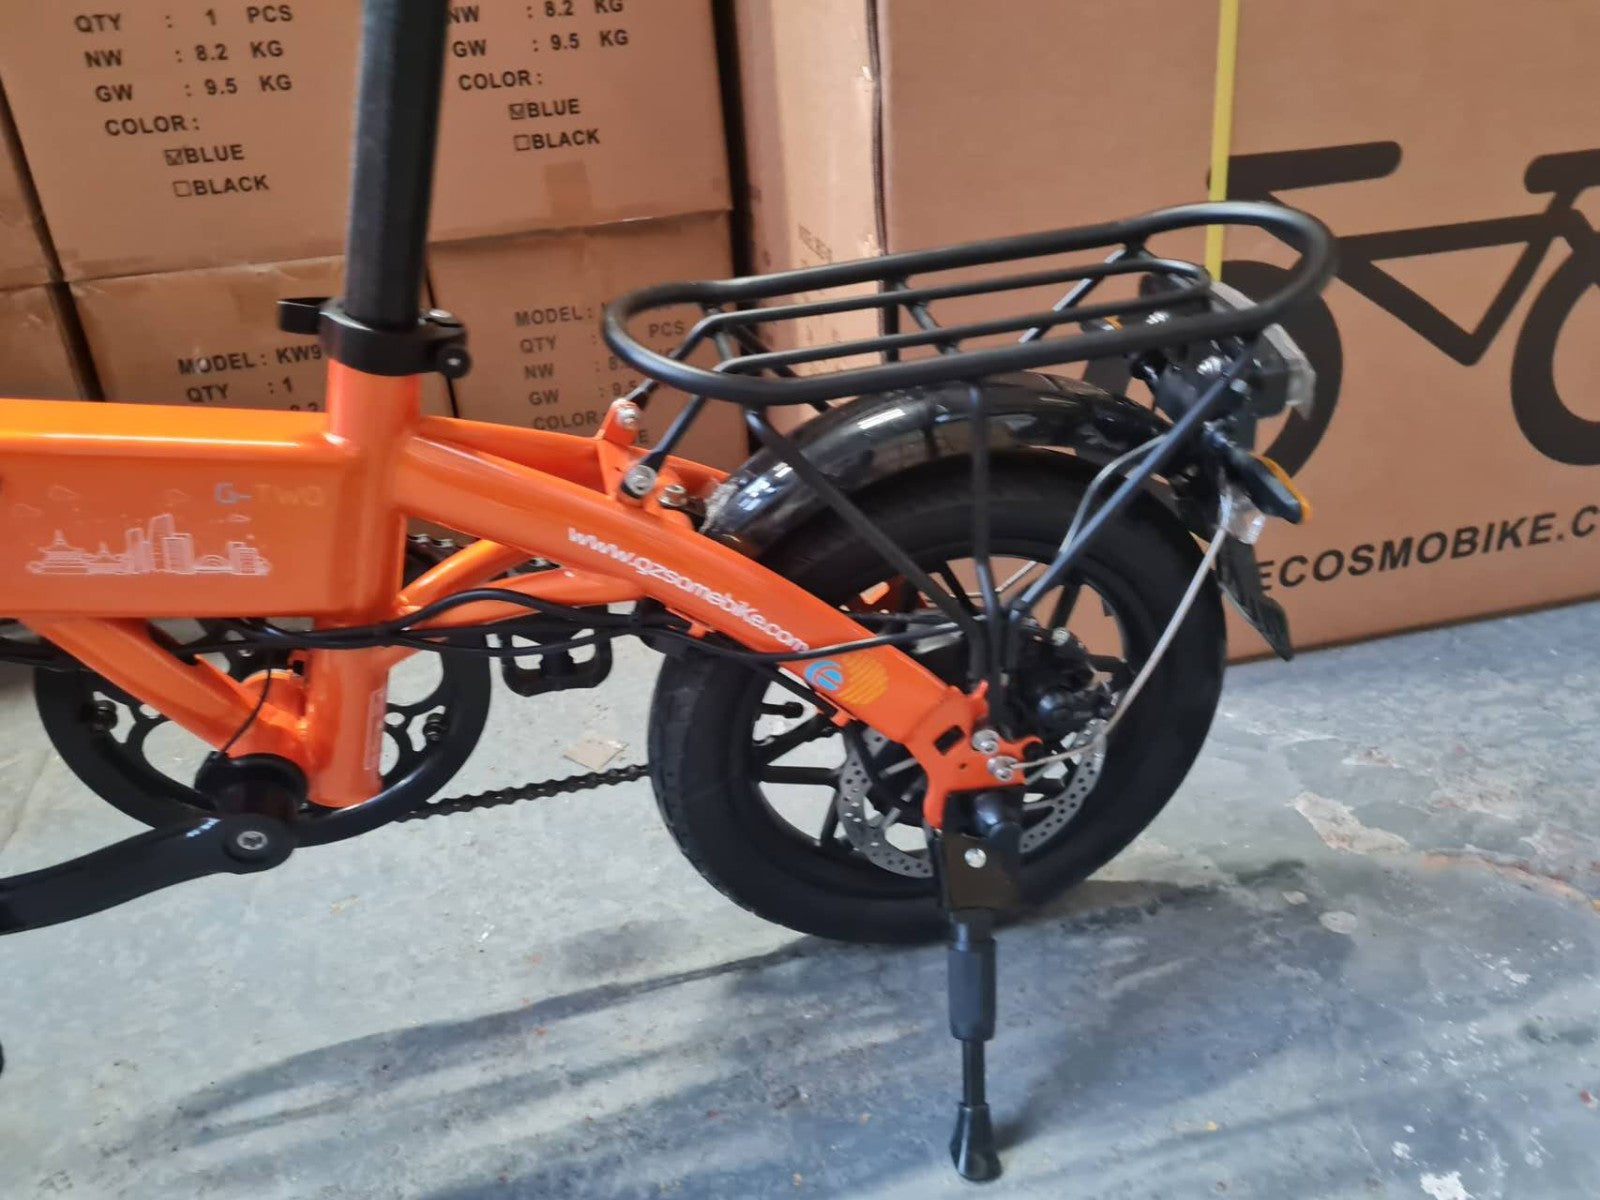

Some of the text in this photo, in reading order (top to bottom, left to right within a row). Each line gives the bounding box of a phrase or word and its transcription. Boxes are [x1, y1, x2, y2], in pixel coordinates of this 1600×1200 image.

[74, 13, 121, 33] QTY
[205, 8, 217, 26] 1
[246, 4, 293, 24] PCS
[449, 5, 480, 24] NW
[544, 0, 574, 17] 8.2
[594, 0, 624, 14] KG
[84, 49, 122, 68] NW
[194, 43, 229, 62] 8.2
[249, 39, 284, 58] KG
[452, 39, 487, 58] GW
[550, 32, 580, 51] 9.5
[599, 29, 629, 47] KG
[95, 84, 133, 103] GW
[204, 77, 238, 96] 9.5
[259, 73, 293, 92] KG
[527, 98, 581, 119] BLUE
[531, 128, 601, 150] BLACK
[185, 143, 245, 164] BLUE
[193, 174, 270, 196] BLACK
[519, 335, 557, 355] QTY
[648, 319, 685, 338] PCS
[524, 362, 554, 380] NW
[186, 383, 228, 404] QTY
[282, 376, 292, 393] 1
[528, 389, 559, 406] GW
